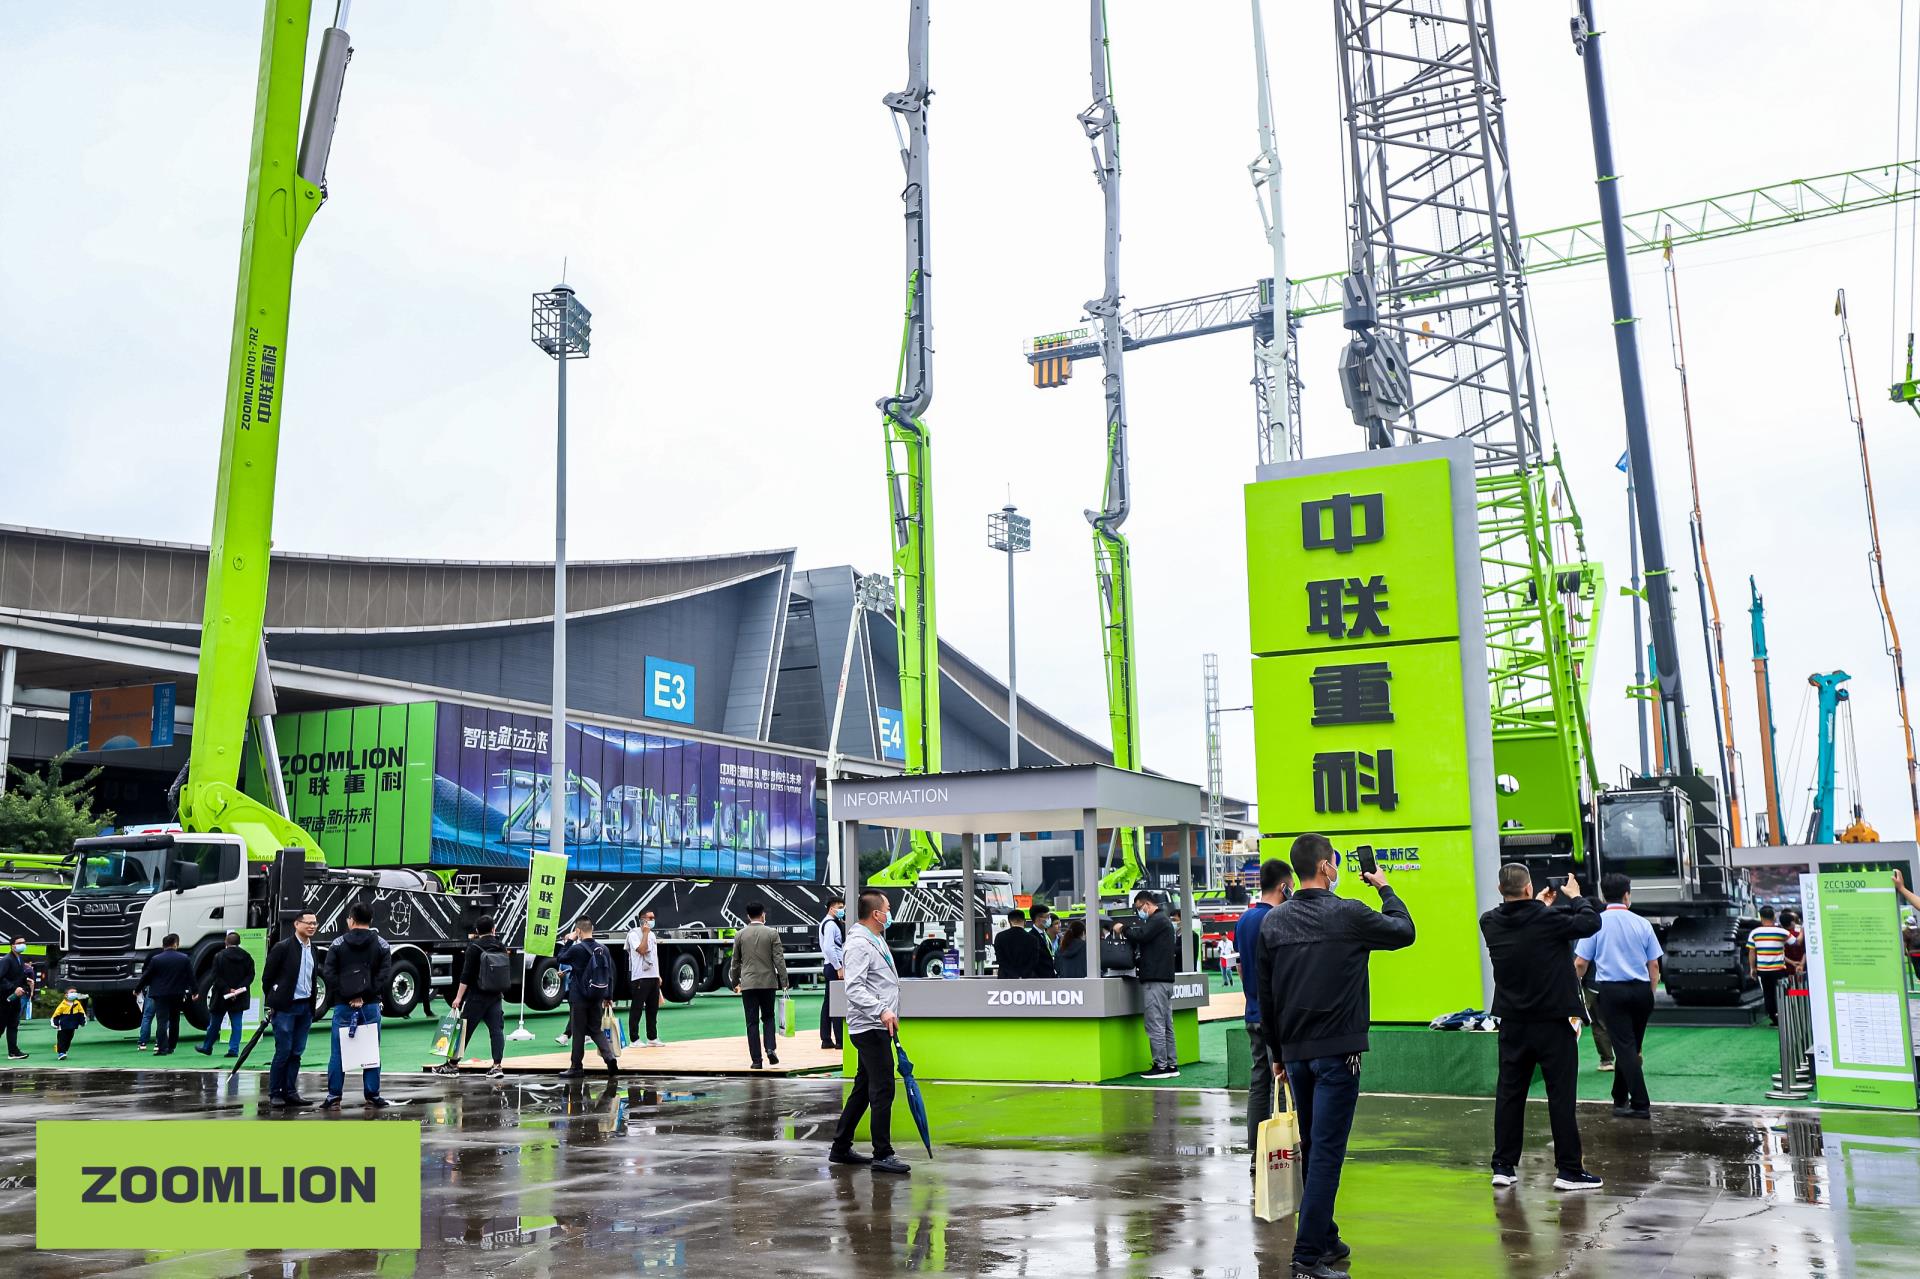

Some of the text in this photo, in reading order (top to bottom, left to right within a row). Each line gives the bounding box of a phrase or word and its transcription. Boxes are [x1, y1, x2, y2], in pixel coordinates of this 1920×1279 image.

[257, 344, 277, 423] 中联重科
[1301, 491, 1399, 813] 中联重科
[654, 669, 686, 710] E3
[879, 717, 902, 749] E4
[279, 746, 404, 776] ZOOMLION
[843, 787, 949, 808] INFORMATION
[1824, 880, 1867, 889] ZCC13000
[84, 903, 121, 913] SCANIA
[534, 874, 556, 937] 中联重科
[987, 990, 1084, 1005] ZOOMLION
